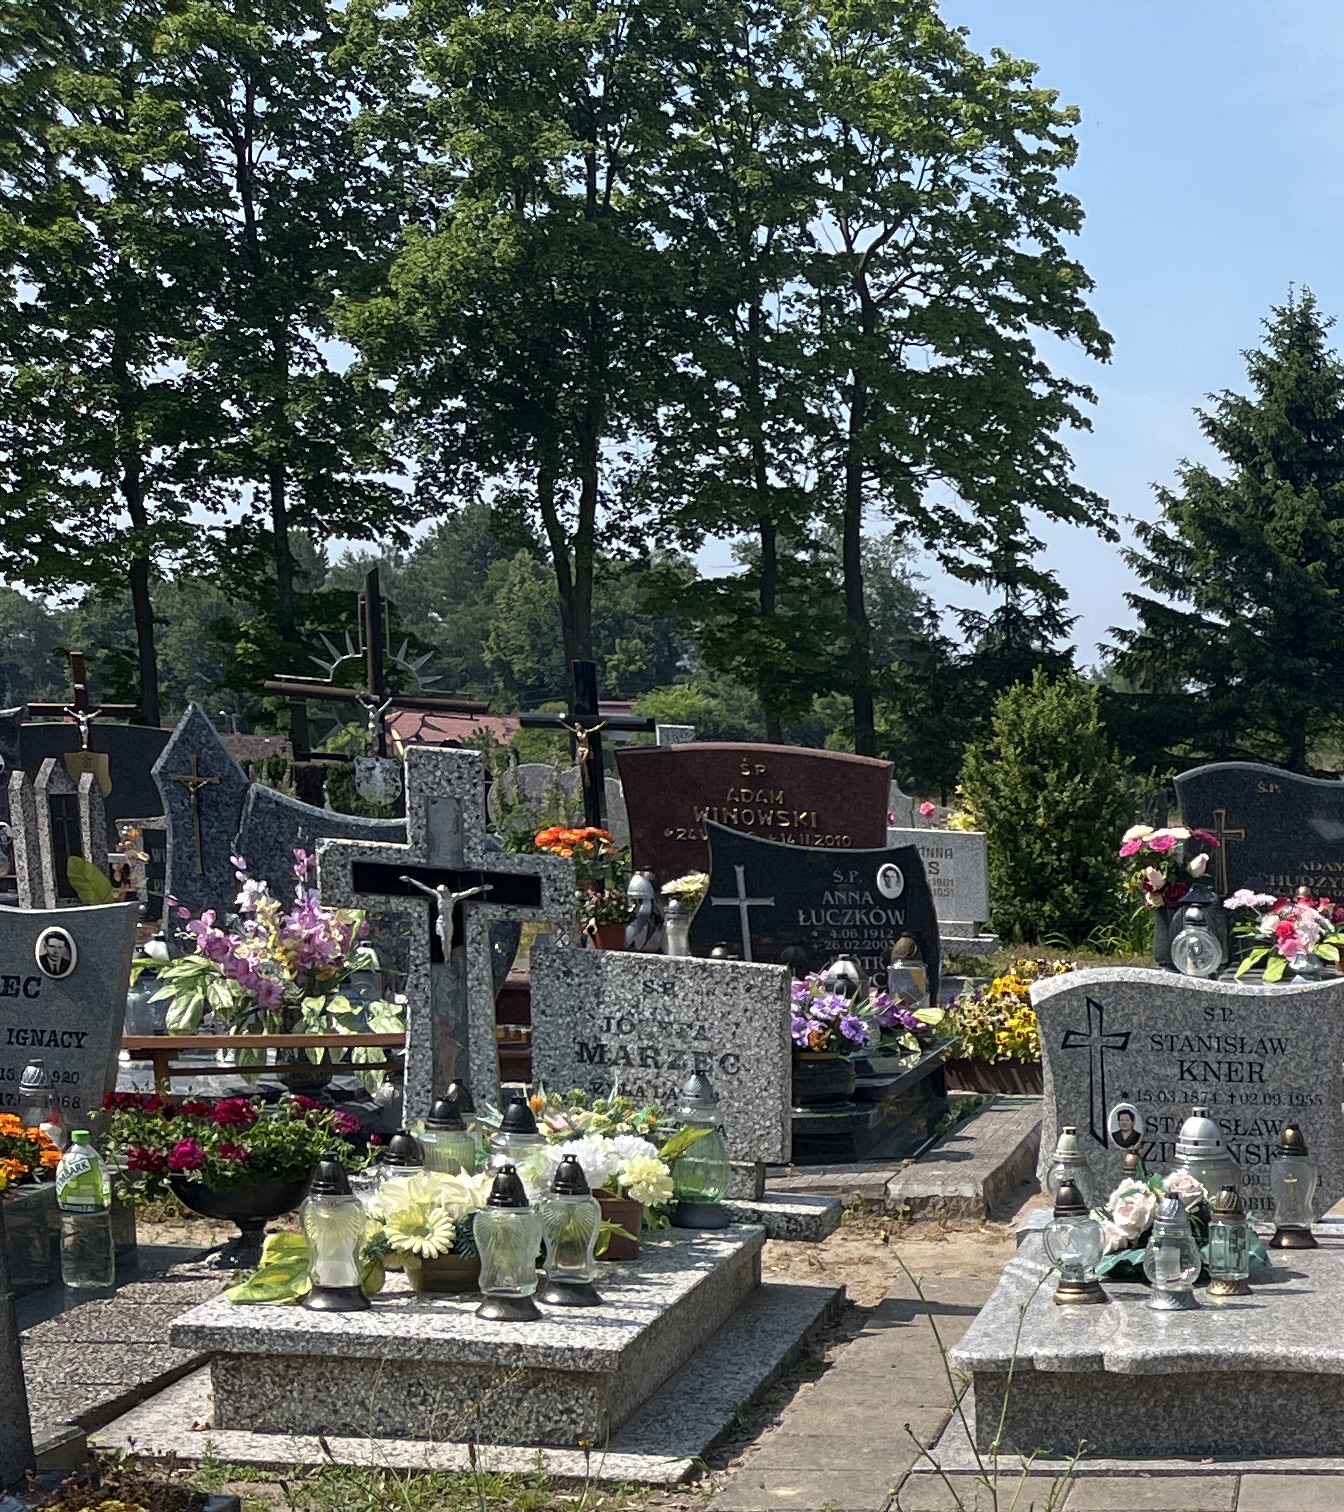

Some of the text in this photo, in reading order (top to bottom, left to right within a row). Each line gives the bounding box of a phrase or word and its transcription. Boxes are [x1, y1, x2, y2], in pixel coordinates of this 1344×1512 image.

[726, 788, 785, 805] ADAM
[693, 805, 818, 829] WINOWSKI
[822, 891, 874, 906] ANNA
[798, 906, 906, 926] ŁUCZKÓW
[6, 1027, 89, 1049] IGNACY
[1150, 1033, 1290, 1055] STANISŁAW
[576, 1042, 741, 1076] MARZEC
[1177, 1059, 1266, 1084] KNER
